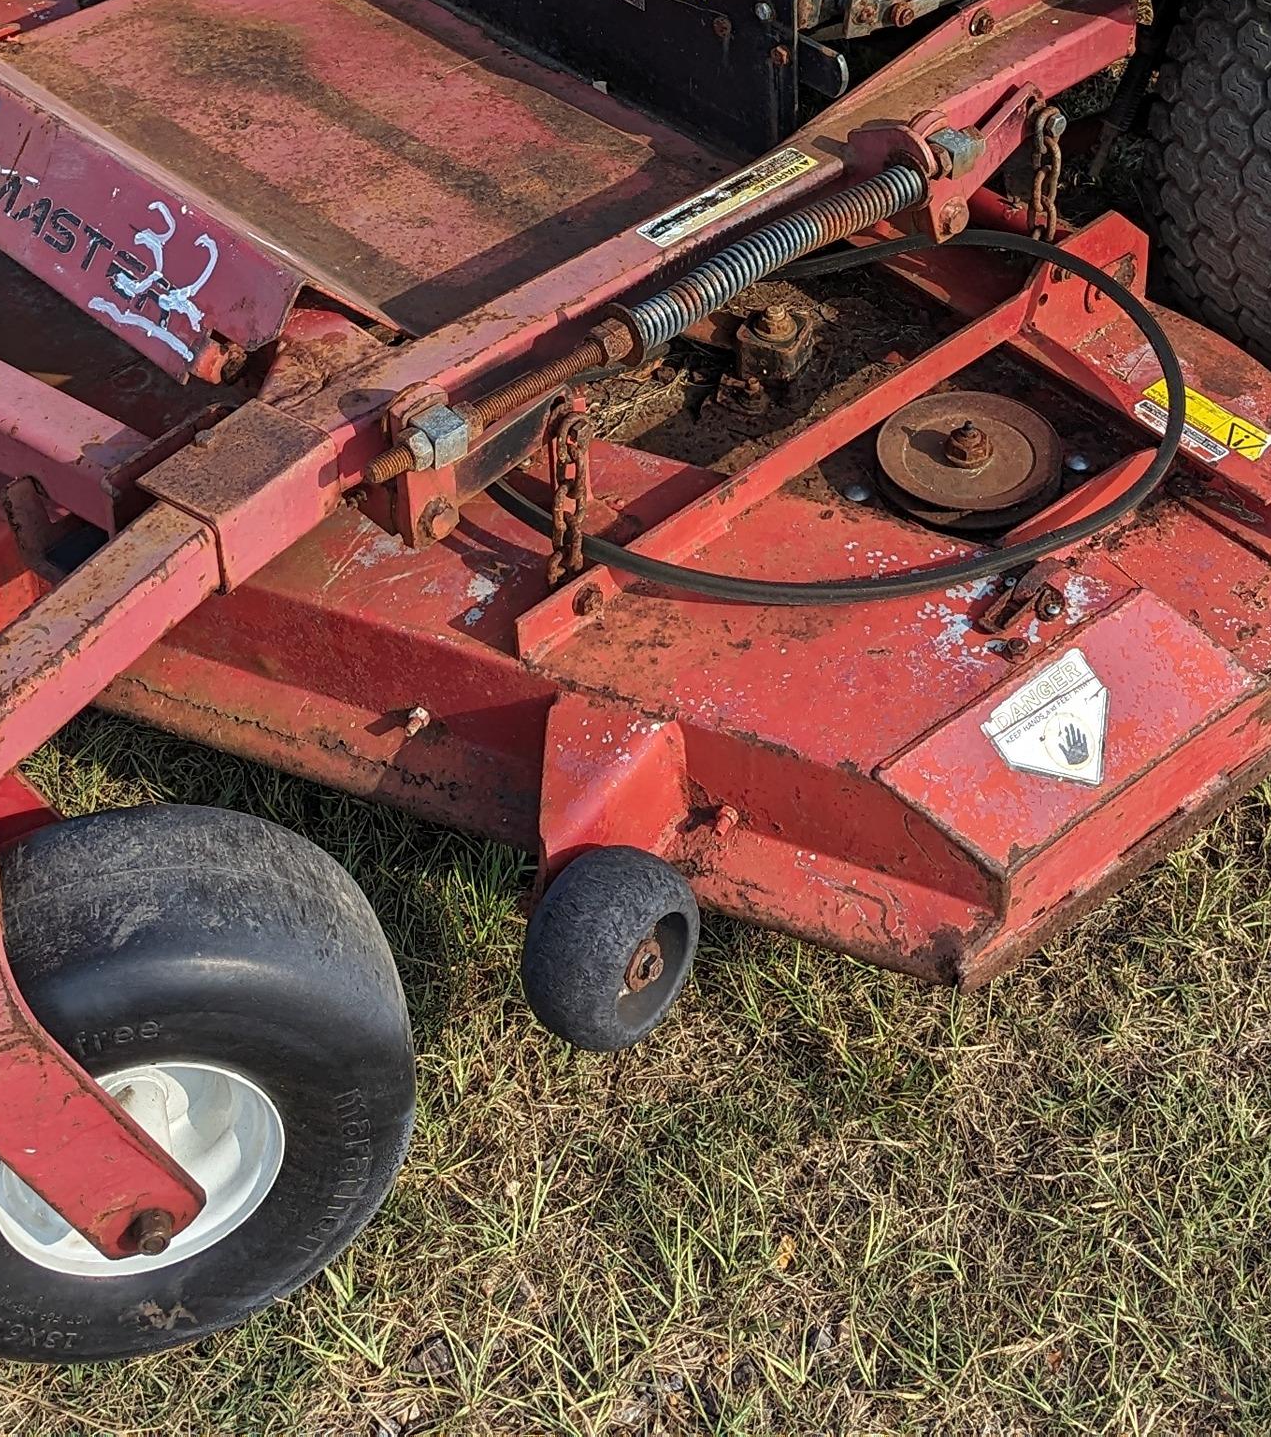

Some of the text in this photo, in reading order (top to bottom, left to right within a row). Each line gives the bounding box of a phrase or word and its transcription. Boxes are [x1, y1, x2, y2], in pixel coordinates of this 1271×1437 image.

[993, 660, 1083, 733] DANGER
[1005, 728, 1023, 746] KEEP
[1022, 711, 1046, 733] HANDS
[1056, 692, 1074, 708] FEET
